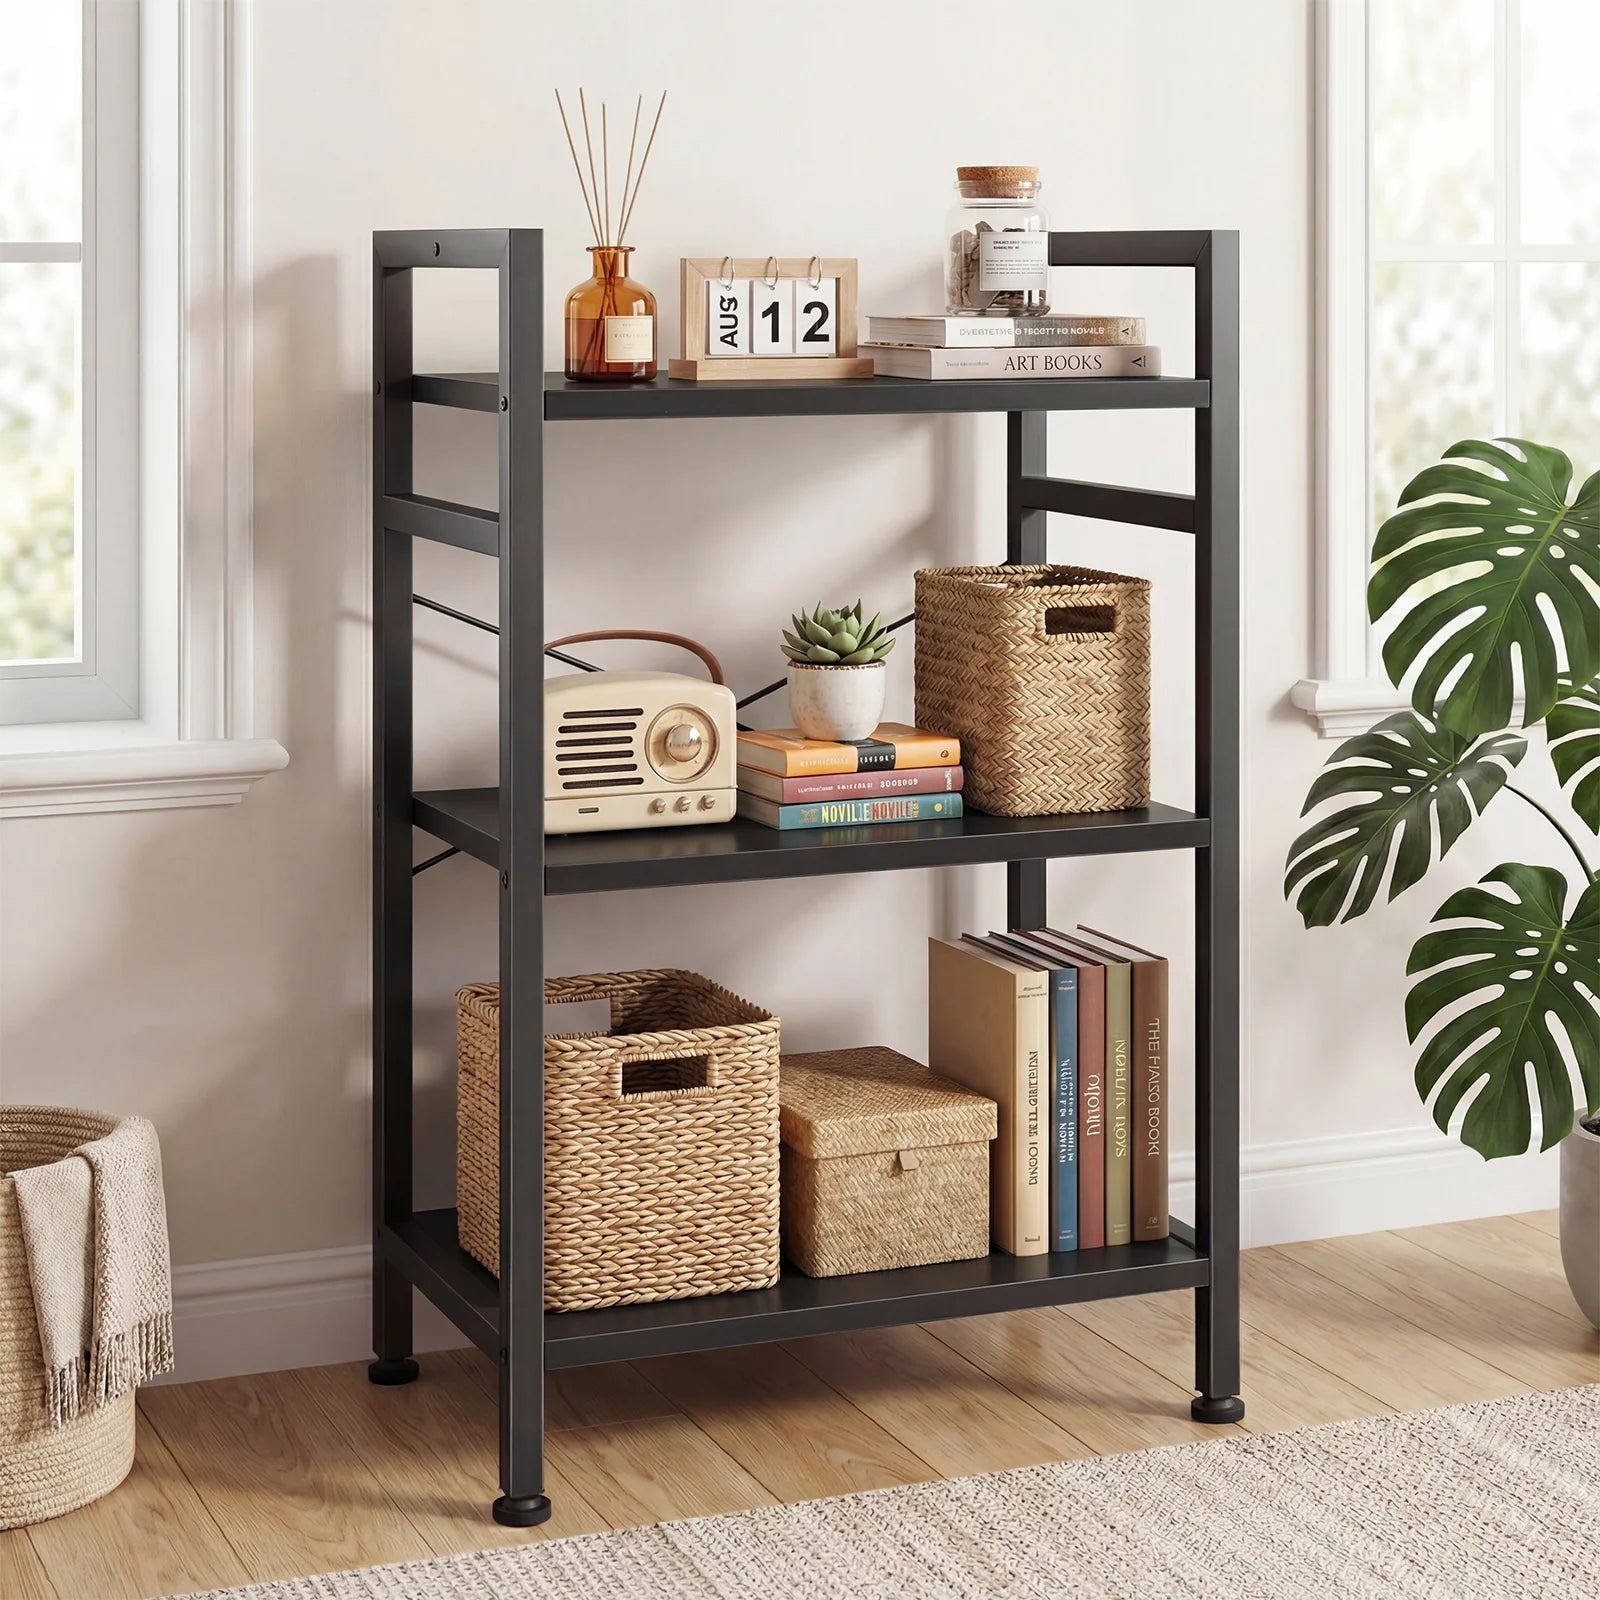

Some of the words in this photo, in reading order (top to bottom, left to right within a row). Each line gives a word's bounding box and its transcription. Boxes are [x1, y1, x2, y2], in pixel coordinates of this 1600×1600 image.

[1004, 355, 1039, 371] ART
[1044, 354, 1103, 371] BOOKS
[1149, 1018, 1160, 1051] THE
